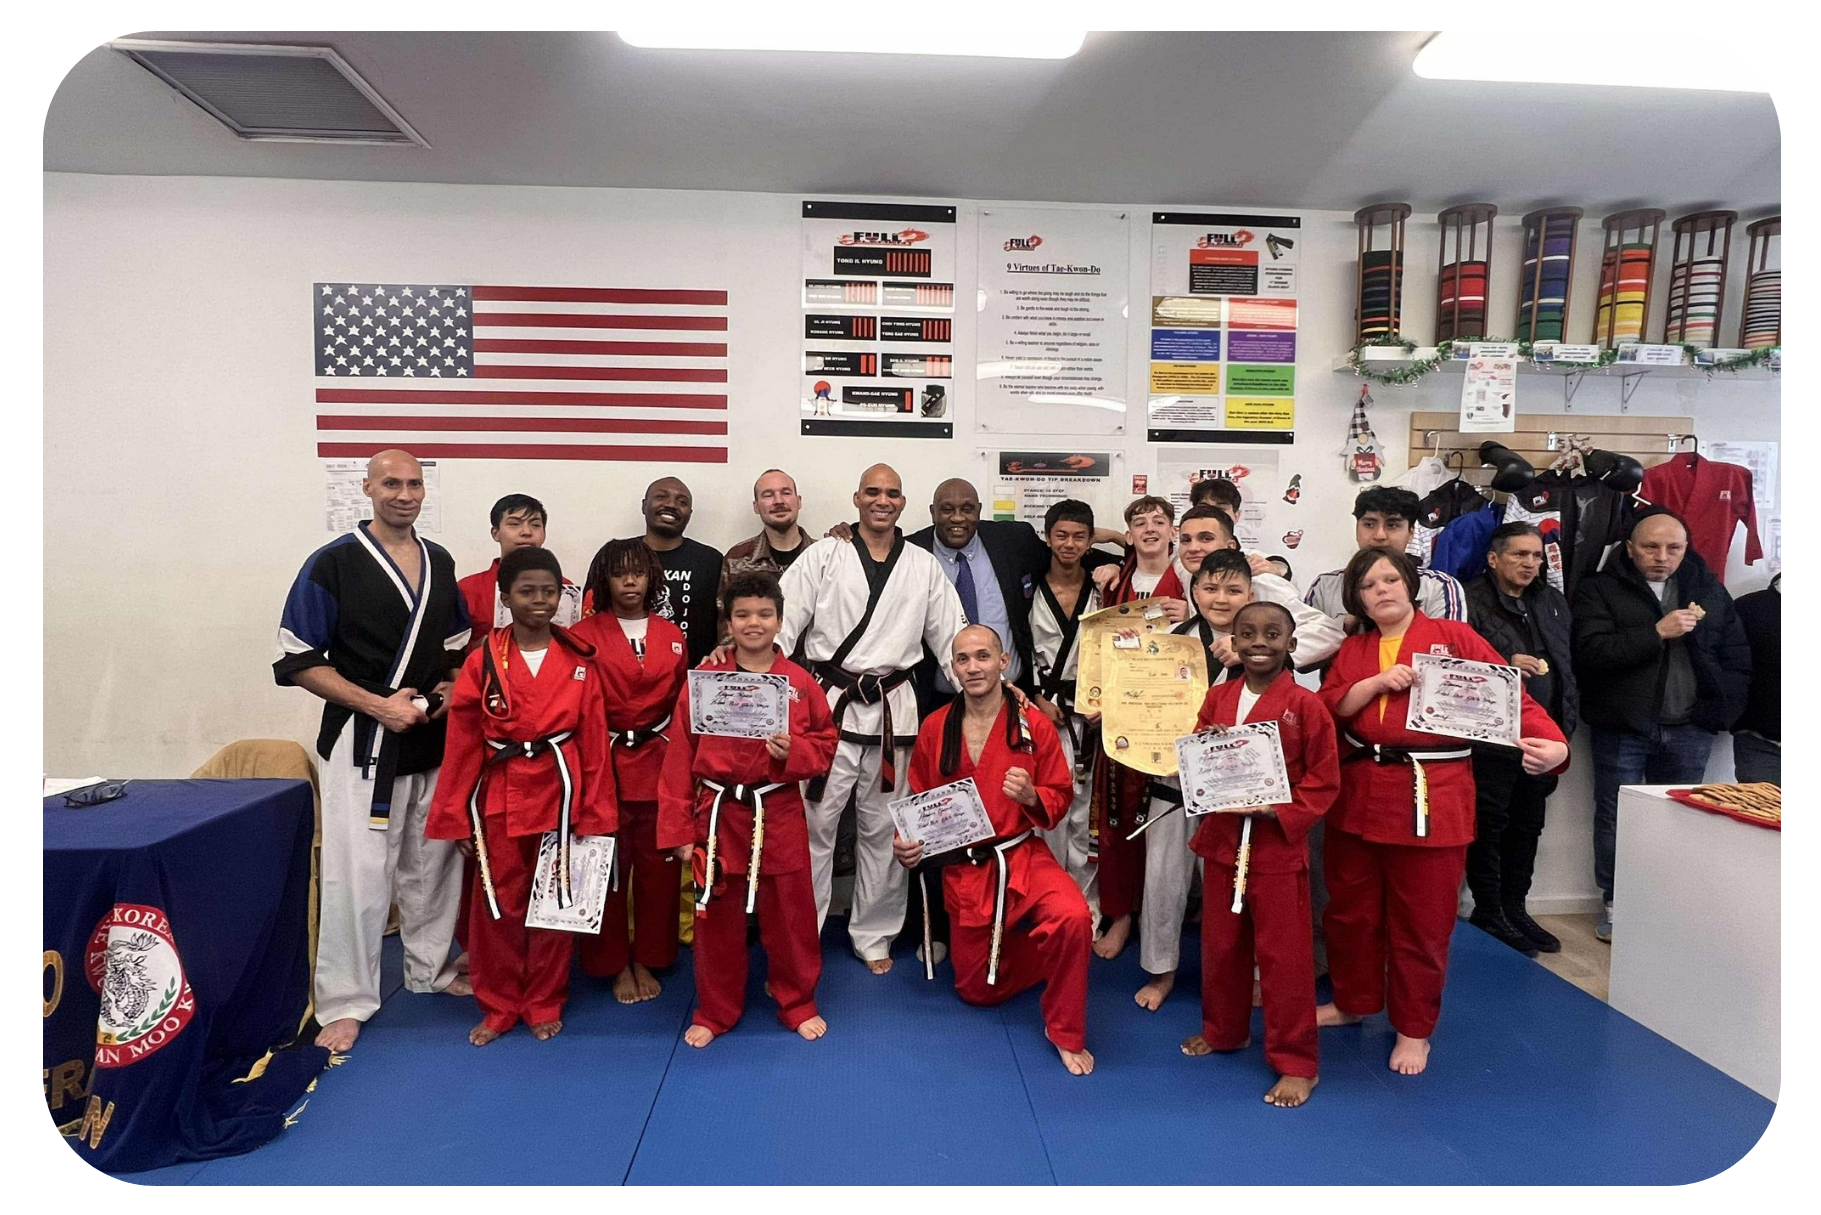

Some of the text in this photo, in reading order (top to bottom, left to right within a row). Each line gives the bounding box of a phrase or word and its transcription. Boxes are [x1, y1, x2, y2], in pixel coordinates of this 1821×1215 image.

[854, 231, 902, 243] FULL
[1207, 233, 1237, 244] FULL
[1010, 238, 1031, 248] FULL
[1006, 263, 1101, 273] 9 Virtues of Tae-Kwon-Do
[1200, 469, 1232, 479] FULL
